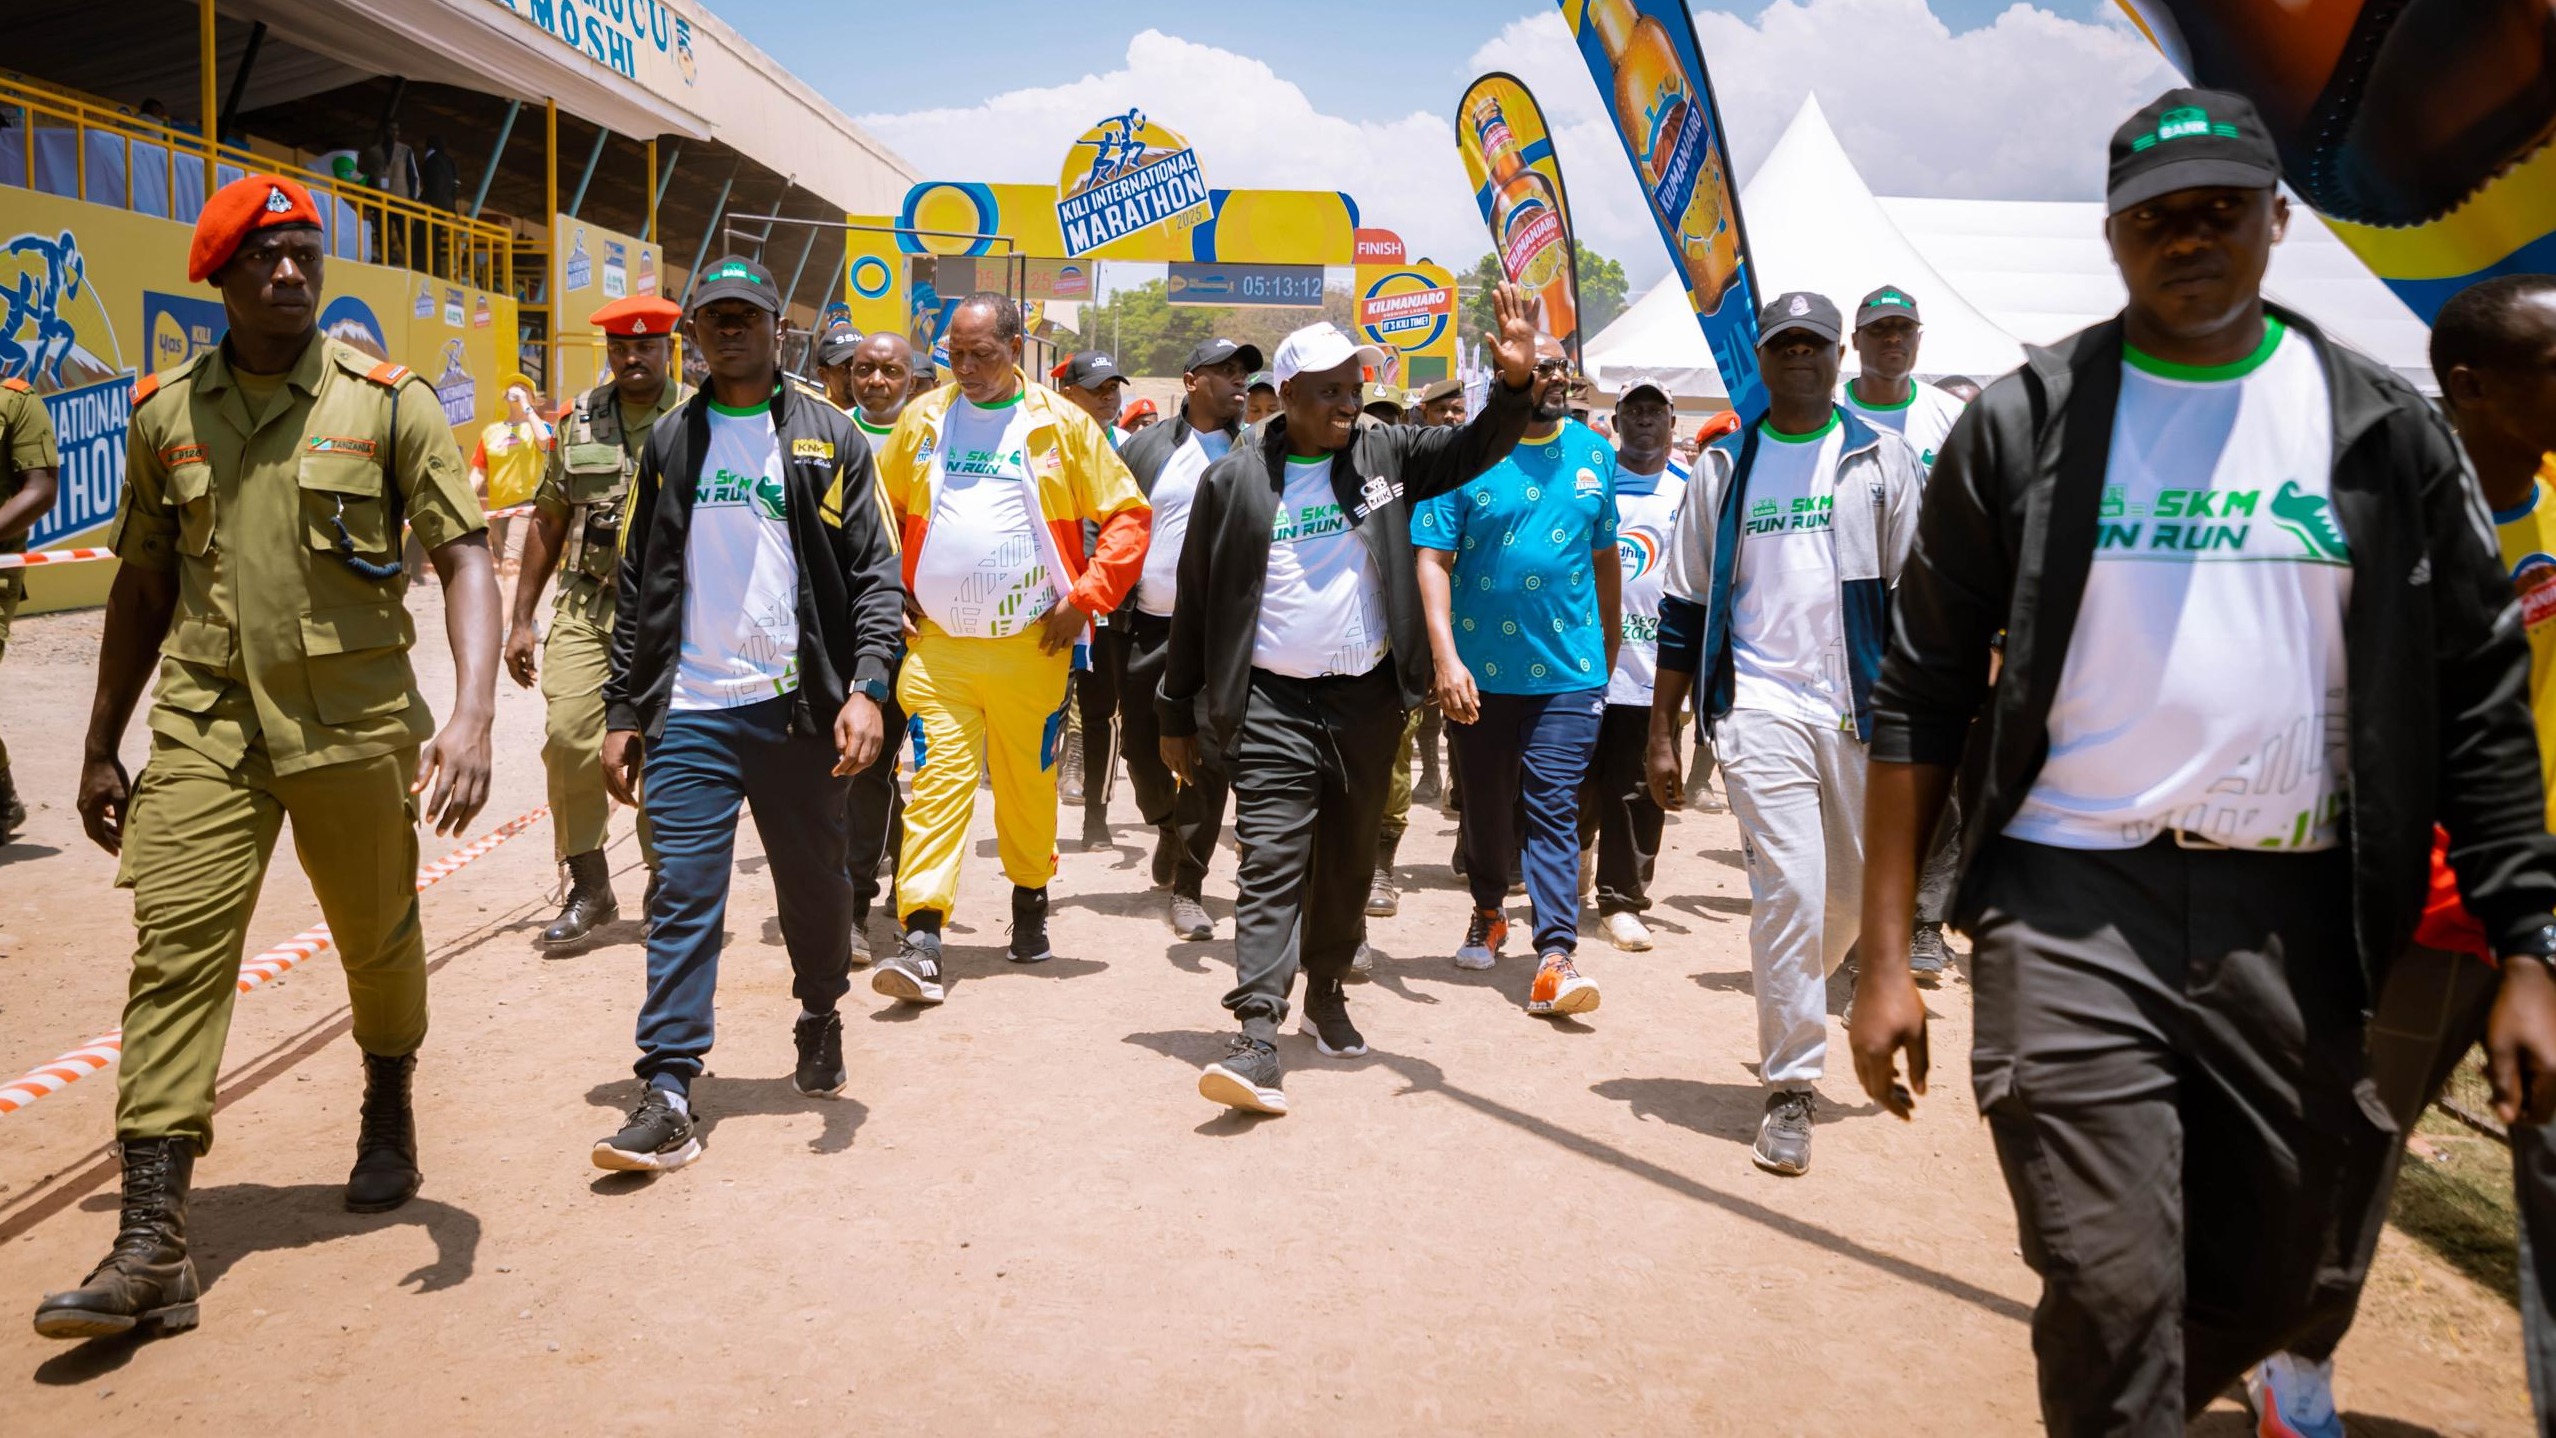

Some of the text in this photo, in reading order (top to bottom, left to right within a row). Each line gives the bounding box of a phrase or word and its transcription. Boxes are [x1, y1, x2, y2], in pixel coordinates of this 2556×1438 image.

[531, 0, 636, 78] MOSHI
[1659, 107, 1702, 214] KILIMANJARO
[1062, 152, 1196, 222] KILI INTERNATIONAL
[1067, 169, 1205, 254] MARATHON
[1176, 207, 1202, 230] 2025
[1358, 241, 1402, 256] FINISH
[1507, 215, 1557, 273] KILIMANJARO
[1243, 275, 1322, 297] 05:13:12
[1368, 290, 1446, 314] KILIMANJARO
[1384, 320, 1396, 331] IT'S
[1396, 318, 1410, 329] KILI
[160, 333, 183, 362] yas
[332, 440, 371, 453] TANZANIA
[797, 443, 825, 456] KNK
[966, 451, 1006, 462] 5KM
[961, 462, 1001, 475] RUN
[1301, 503, 1344, 522] 5KM
[1791, 494, 1833, 513] 5KM
[2152, 490, 2260, 518] 5KM
[1271, 517, 1343, 541] UN RUN
[1746, 512, 1831, 536] FUN RUN
[2151, 524, 2249, 549] RUN
